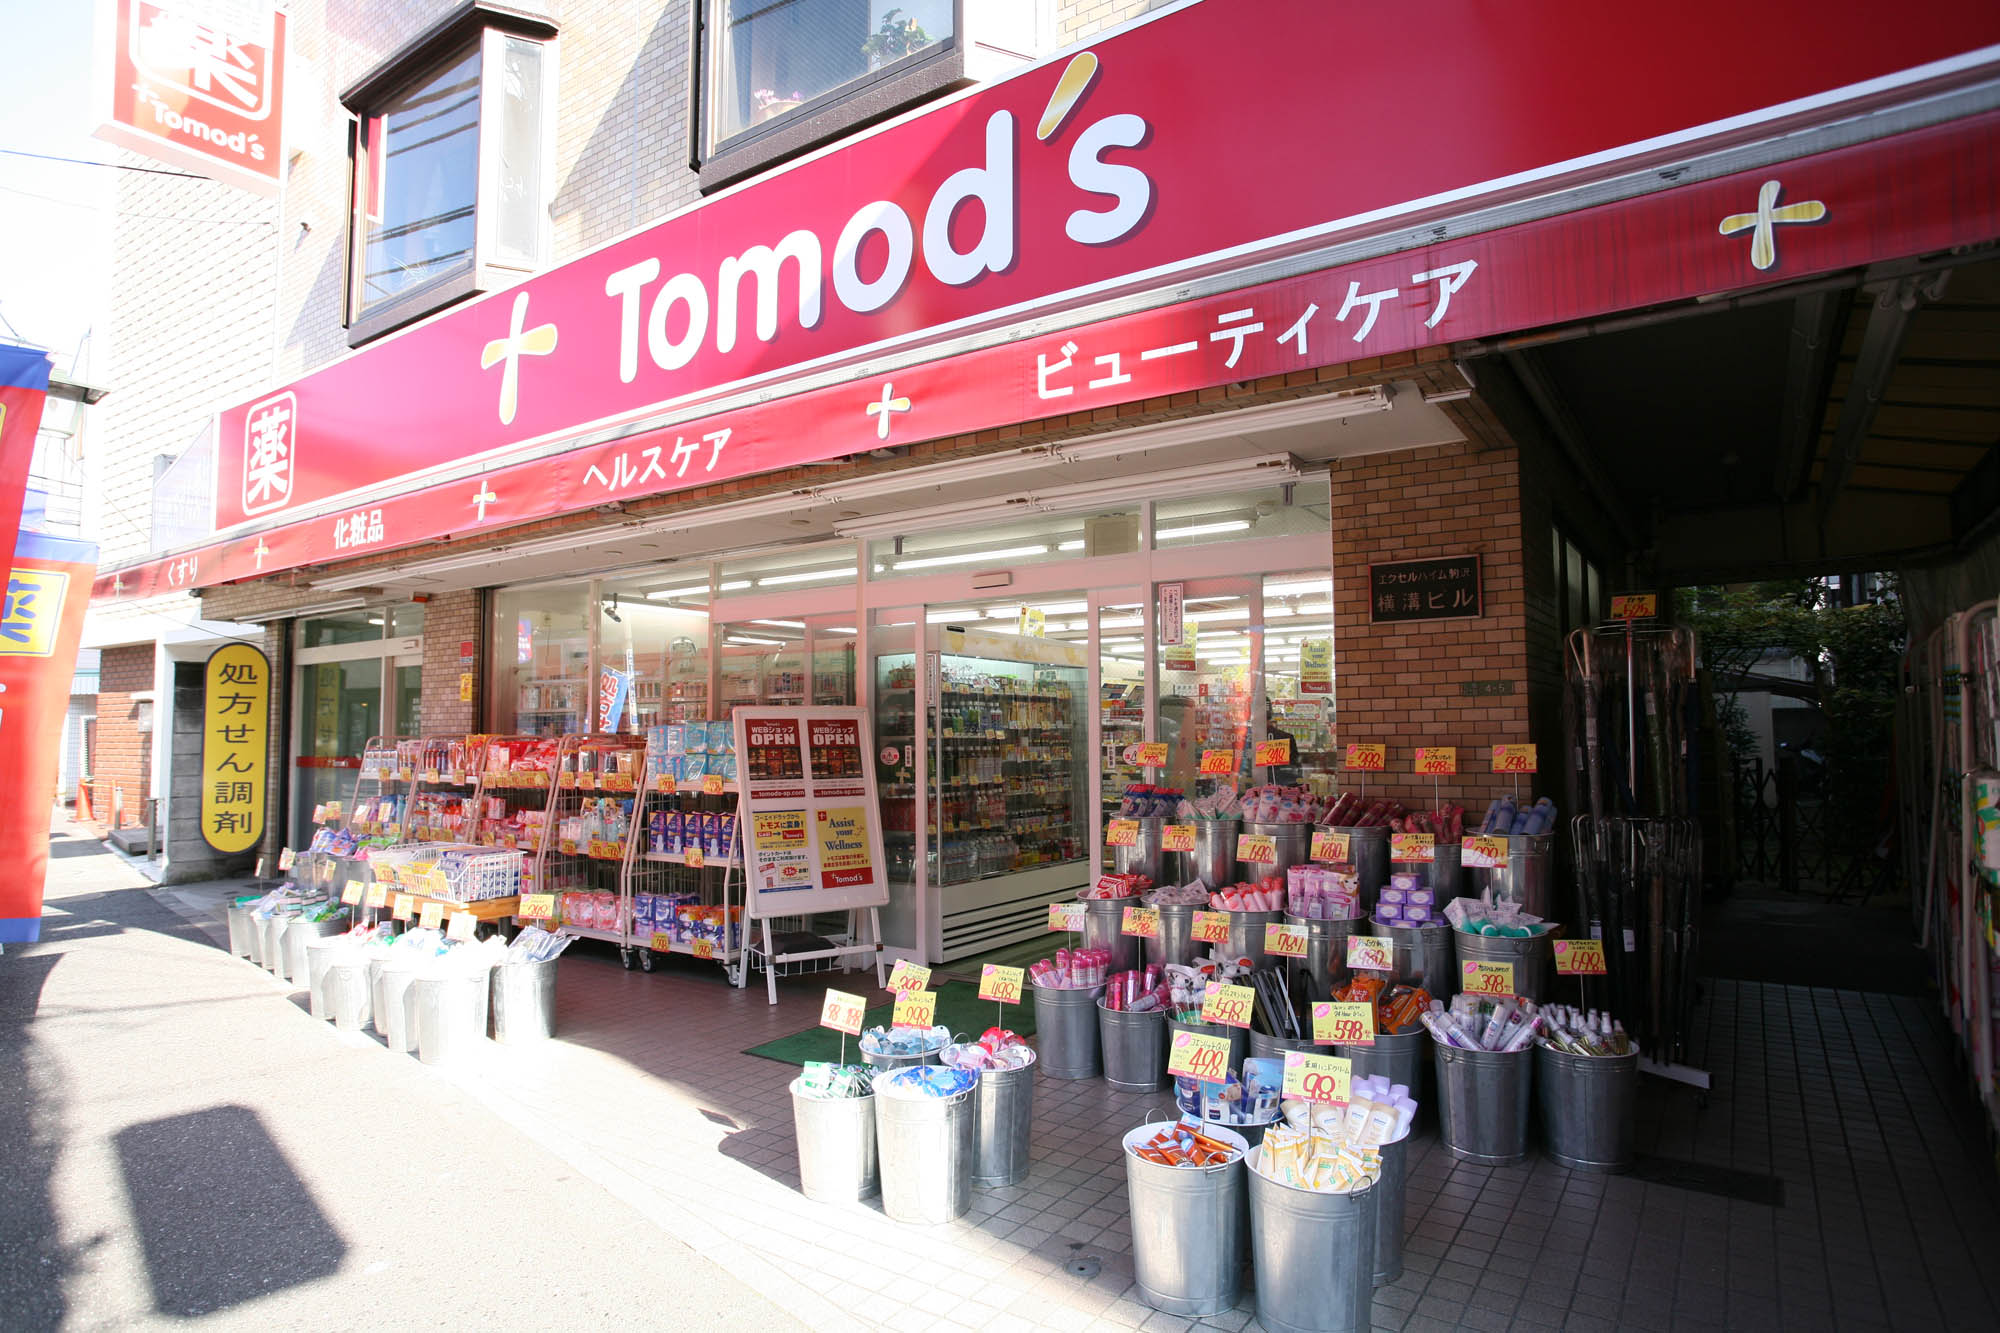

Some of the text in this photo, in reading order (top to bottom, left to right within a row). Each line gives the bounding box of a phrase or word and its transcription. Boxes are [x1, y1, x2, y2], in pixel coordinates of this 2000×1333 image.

[150, 98, 265, 161] Tomod's
[604, 50, 1151, 384] Tomod's
[1037, 259, 1479, 400] ビューティケア
[247, 406, 290, 504] 薬
[582, 427, 733, 492] ヘルスケア
[333, 508, 384, 550] 化粧品
[167, 556, 199, 586] くすり
[751, 726, 794, 734] WEBショップ
[751, 733, 795, 745] OPEN
[813, 733, 855, 745] OPEN
[213, 663, 258, 834] 処方せん調剤
[1424, 760, 1447, 772] 498
[1505, 756, 1527, 770] 298
[829, 817, 856, 828] Assist
[835, 829, 854, 838] your
[824, 840, 863, 851] Wellness
[1249, 844, 1272, 861] 698
[1320, 842, 1342, 859] 1280
[835, 873, 864, 883] Tomod's
[527, 904, 548, 917] 348
[1204, 924, 1229, 940] 1280
[1278, 933, 1304, 952] 787
[1571, 952, 1602, 971] 698
[992, 982, 1014, 999] 498
[1480, 974, 1504, 993] 398
[907, 1006, 929, 1025] 298
[1215, 997, 1245, 1022] 598
[1334, 1020, 1363, 1040] 598
[1189, 1047, 1223, 1076] 498
[1303, 1072, 1335, 1099] 98
